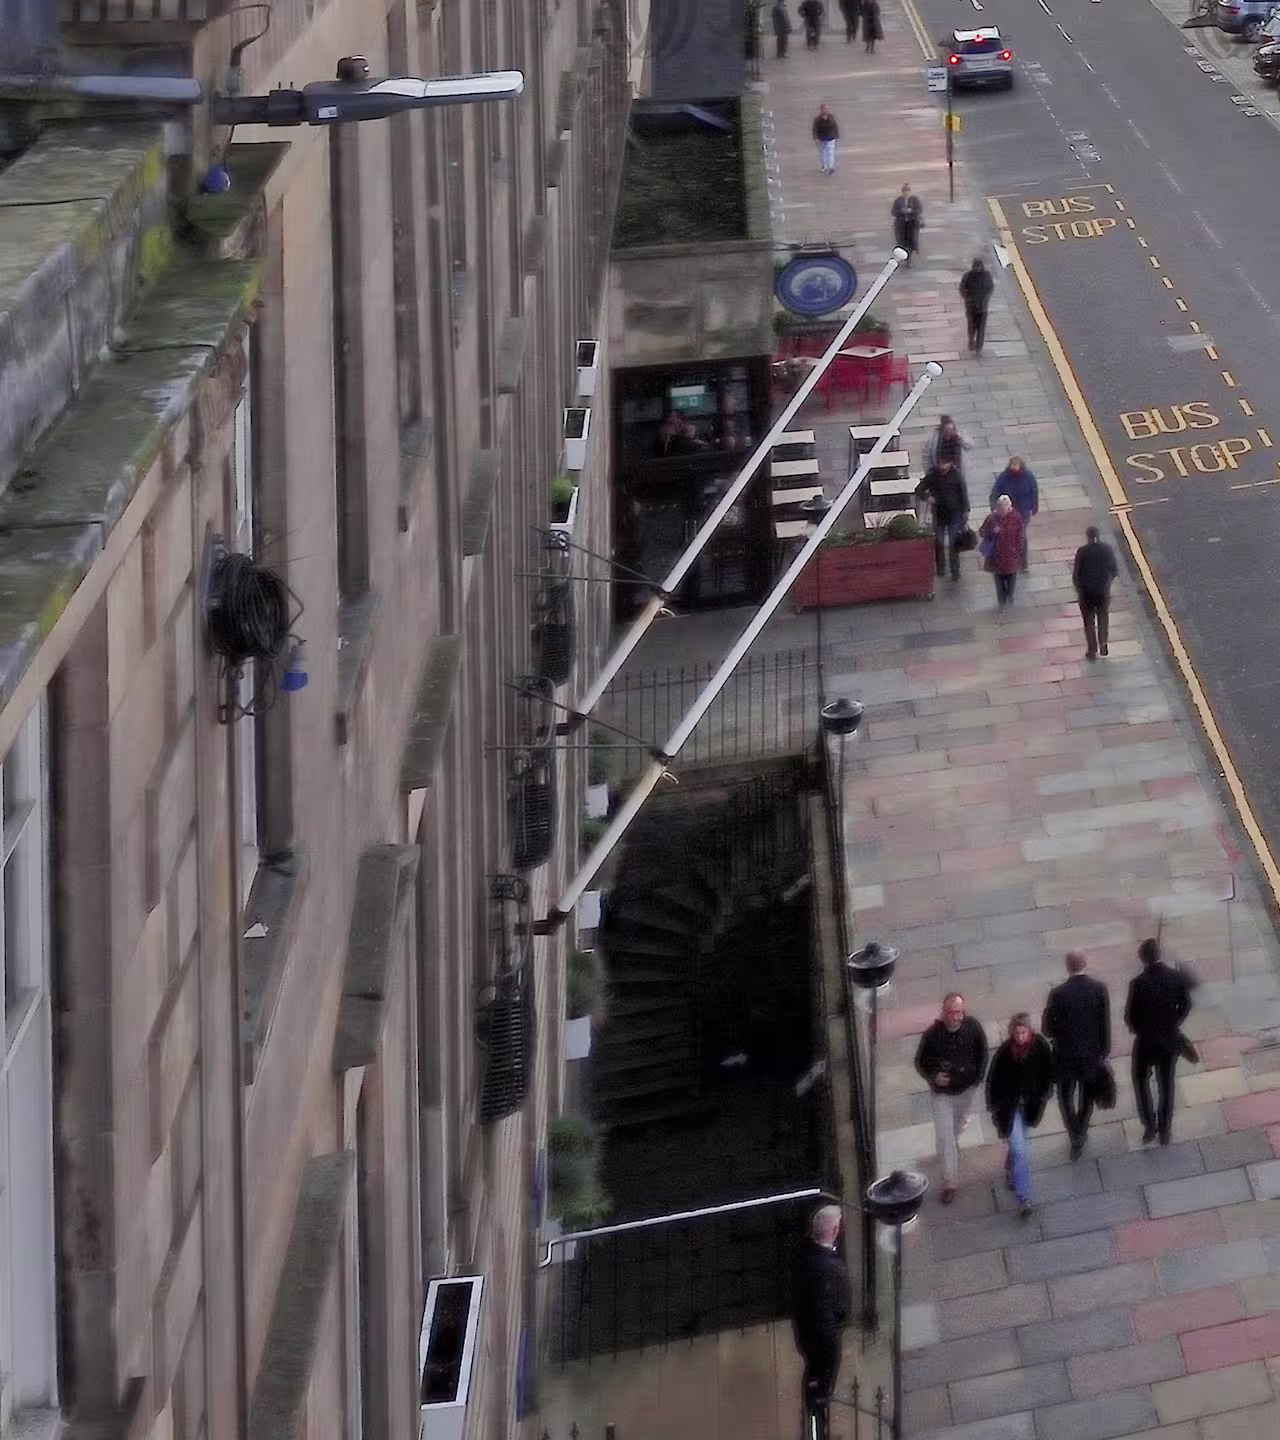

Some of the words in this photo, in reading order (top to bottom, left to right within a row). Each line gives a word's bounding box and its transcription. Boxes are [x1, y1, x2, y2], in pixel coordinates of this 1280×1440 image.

[1021, 196, 1096, 218] BUS
[1022, 217, 1117, 245] STOP
[1119, 401, 1221, 440] BUS
[1125, 437, 1255, 484] STOP
